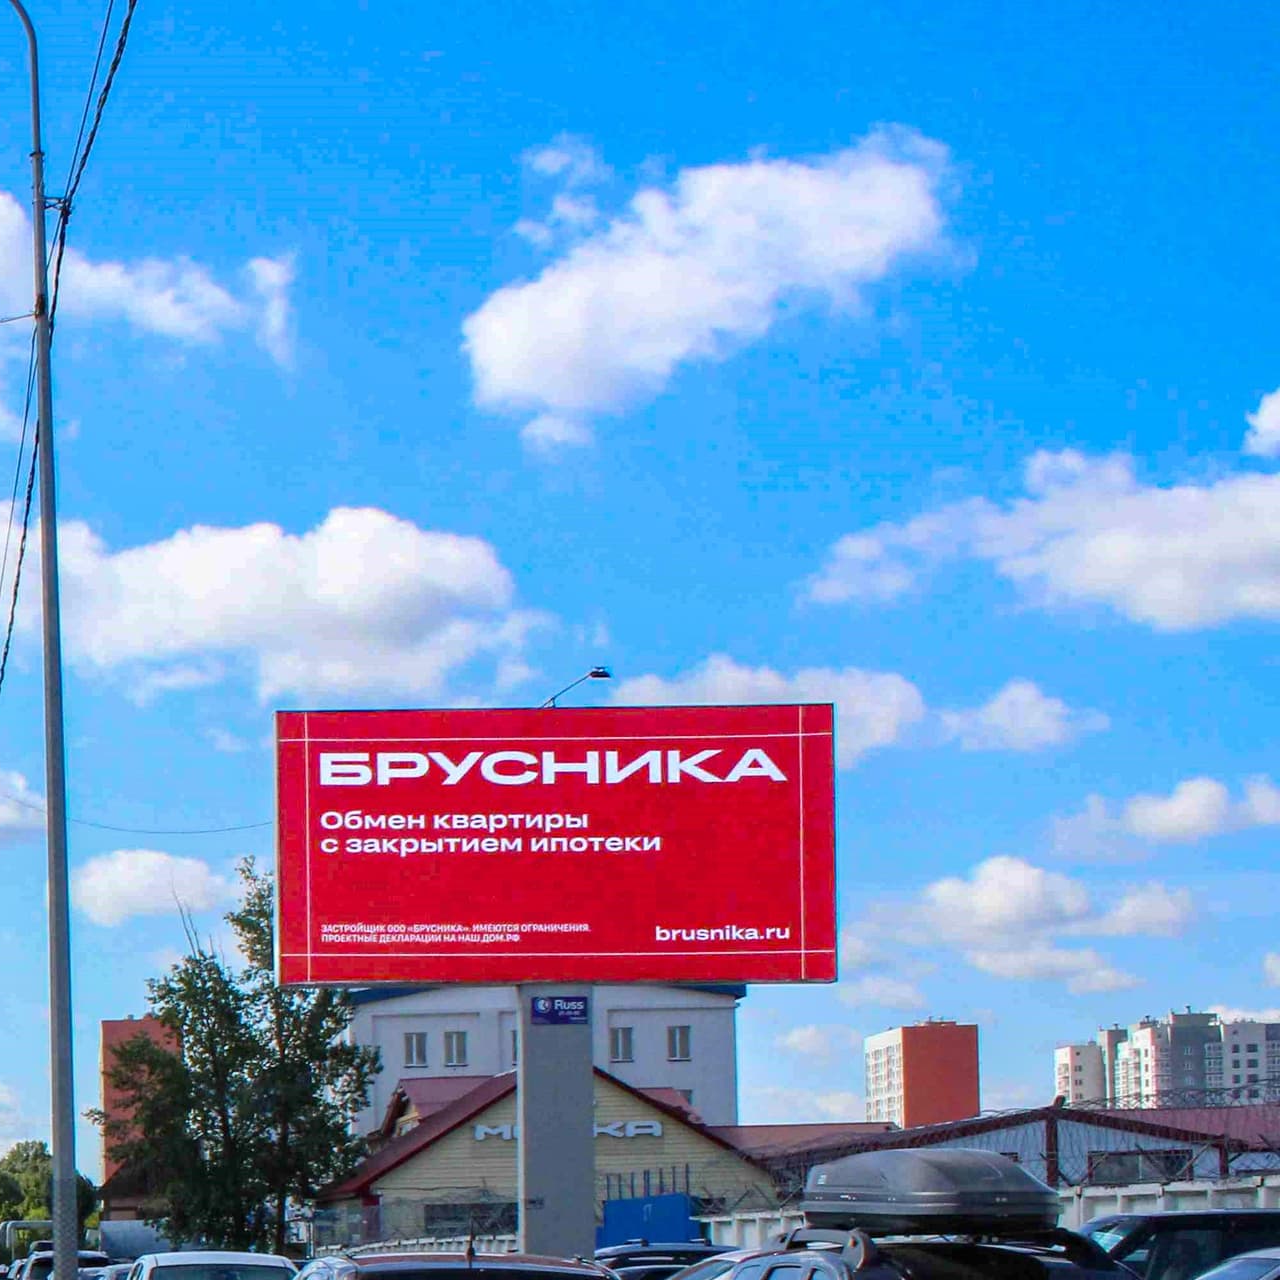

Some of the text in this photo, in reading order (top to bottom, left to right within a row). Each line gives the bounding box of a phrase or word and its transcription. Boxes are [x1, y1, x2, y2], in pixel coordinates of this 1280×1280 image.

[319, 750, 788, 786] БРУСНИКА
[320, 811, 589, 833] Обмен квартиры
[320, 835, 662, 857] с закрытием ипотеки
[655, 925, 790, 942] brusnika.ru
